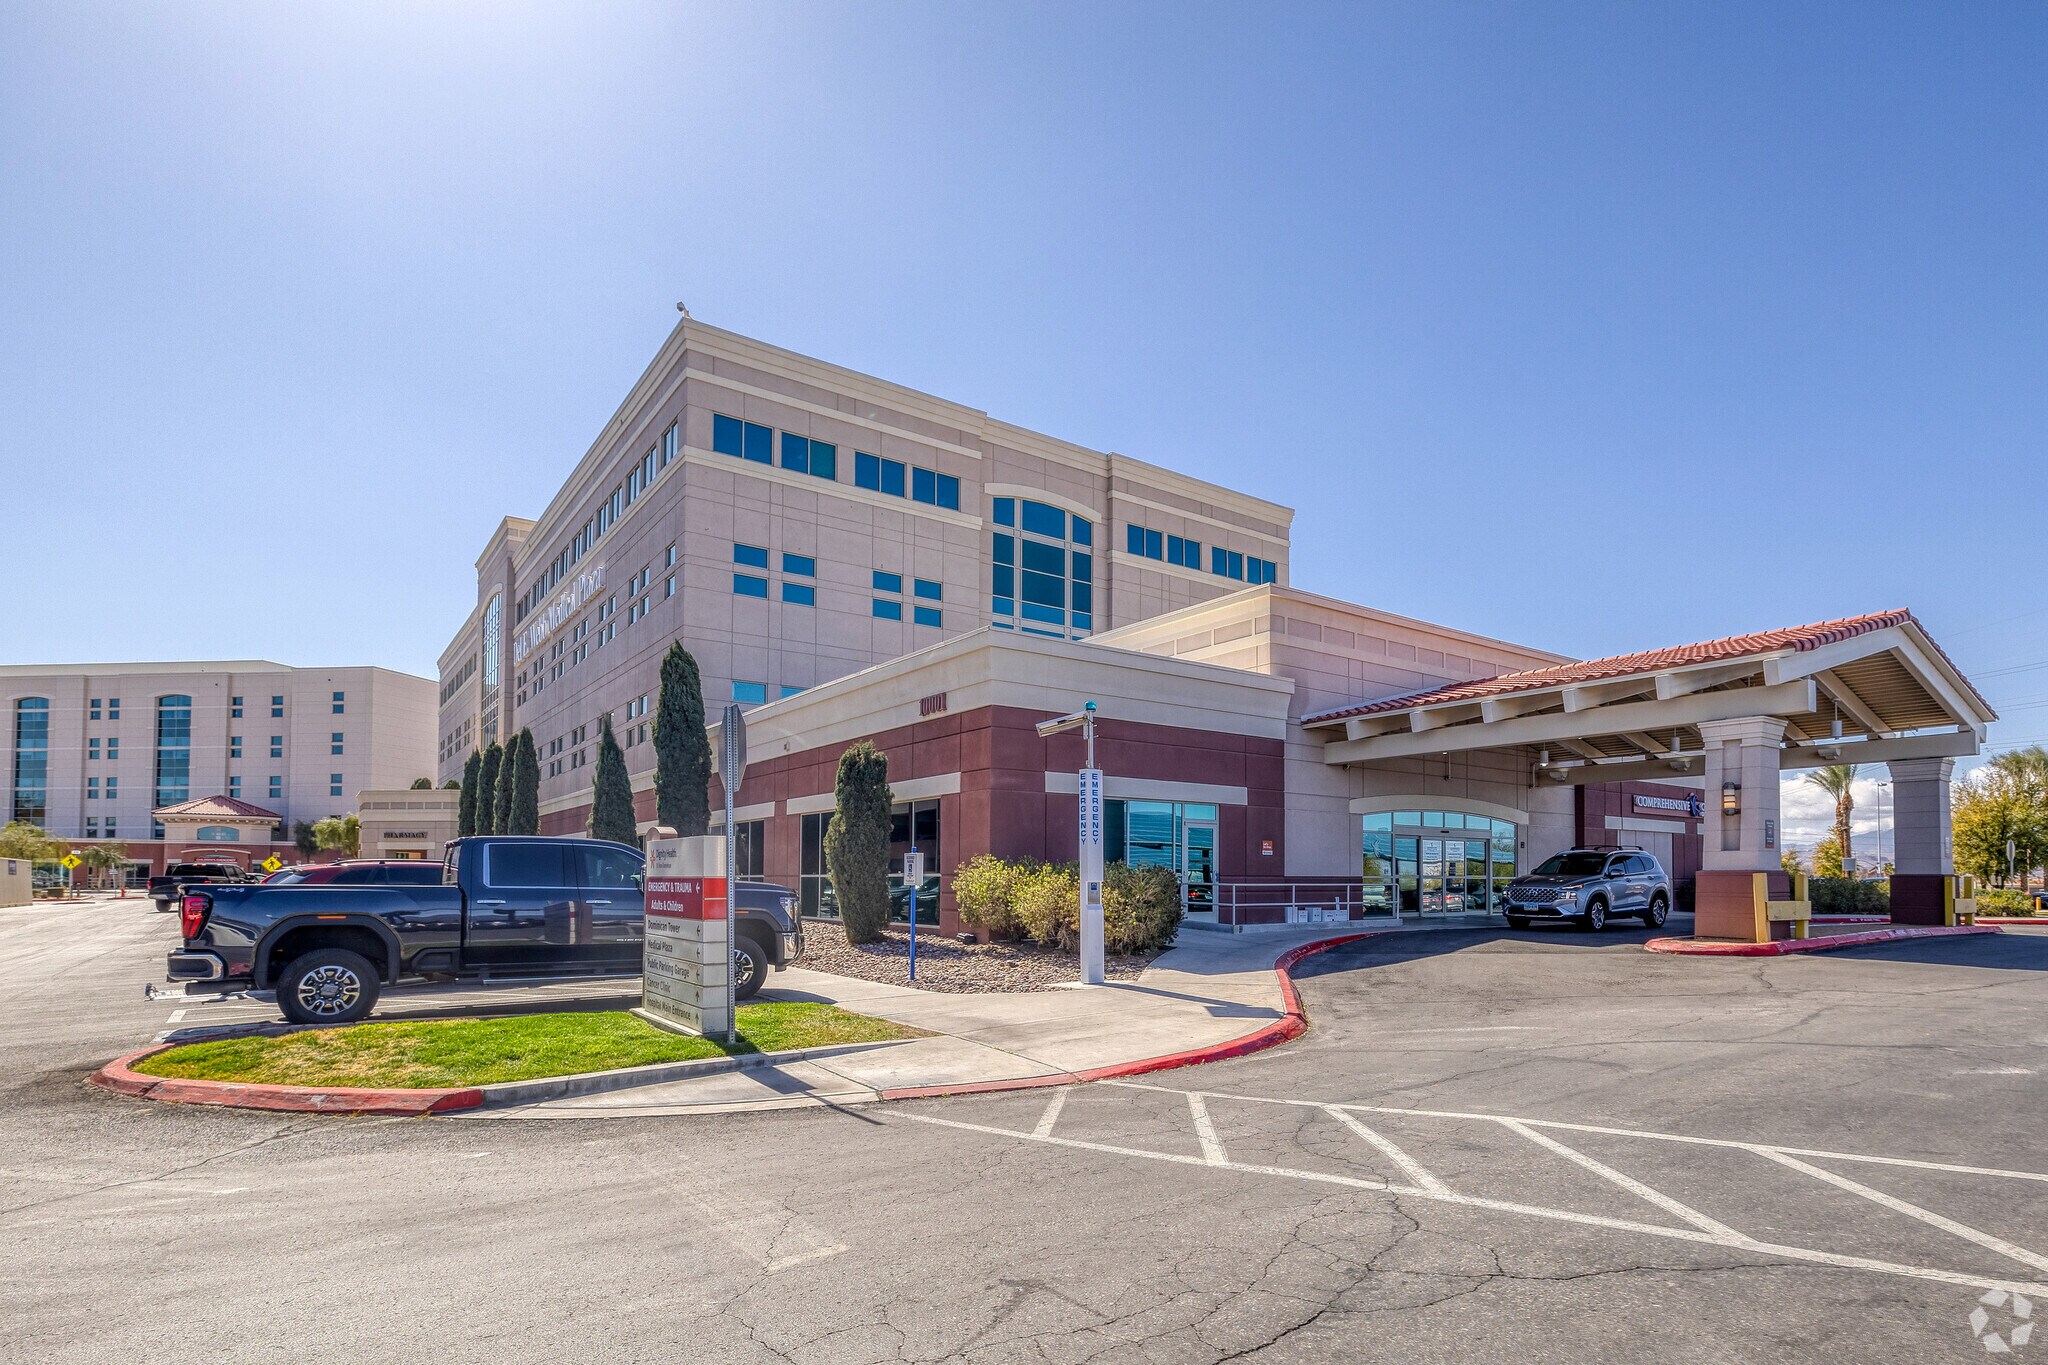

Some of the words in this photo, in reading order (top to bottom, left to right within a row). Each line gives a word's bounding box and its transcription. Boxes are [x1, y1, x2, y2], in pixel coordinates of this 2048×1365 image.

[548, 581, 575, 631] Medical
[578, 565, 604, 607] Plaza
[1637, 795, 1690, 811] COMPREHENSIVE
[383, 831, 428, 839] PHARMACY
[648, 881, 670, 892] EMERGENCY
[675, 882, 692, 893] TRAUMA
[651, 900, 663, 910] Adults
[667, 901, 684, 912] Children
[648, 920, 667, 931] Dominican
[668, 922, 680, 933] Tower
[648, 939, 661, 951] Medical
[662, 941, 673, 953] Plaza
[647, 958, 659, 970] Public
[660, 960, 674, 976] Parking
[674, 964, 690, 979] Garage
[647, 977, 659, 989] Cancer
[660, 981, 670, 993] Clinic
[647, 998, 661, 1011] Hospital
[662, 1001, 671, 1014] Main
[672, 1005, 691, 1020] Entrance
